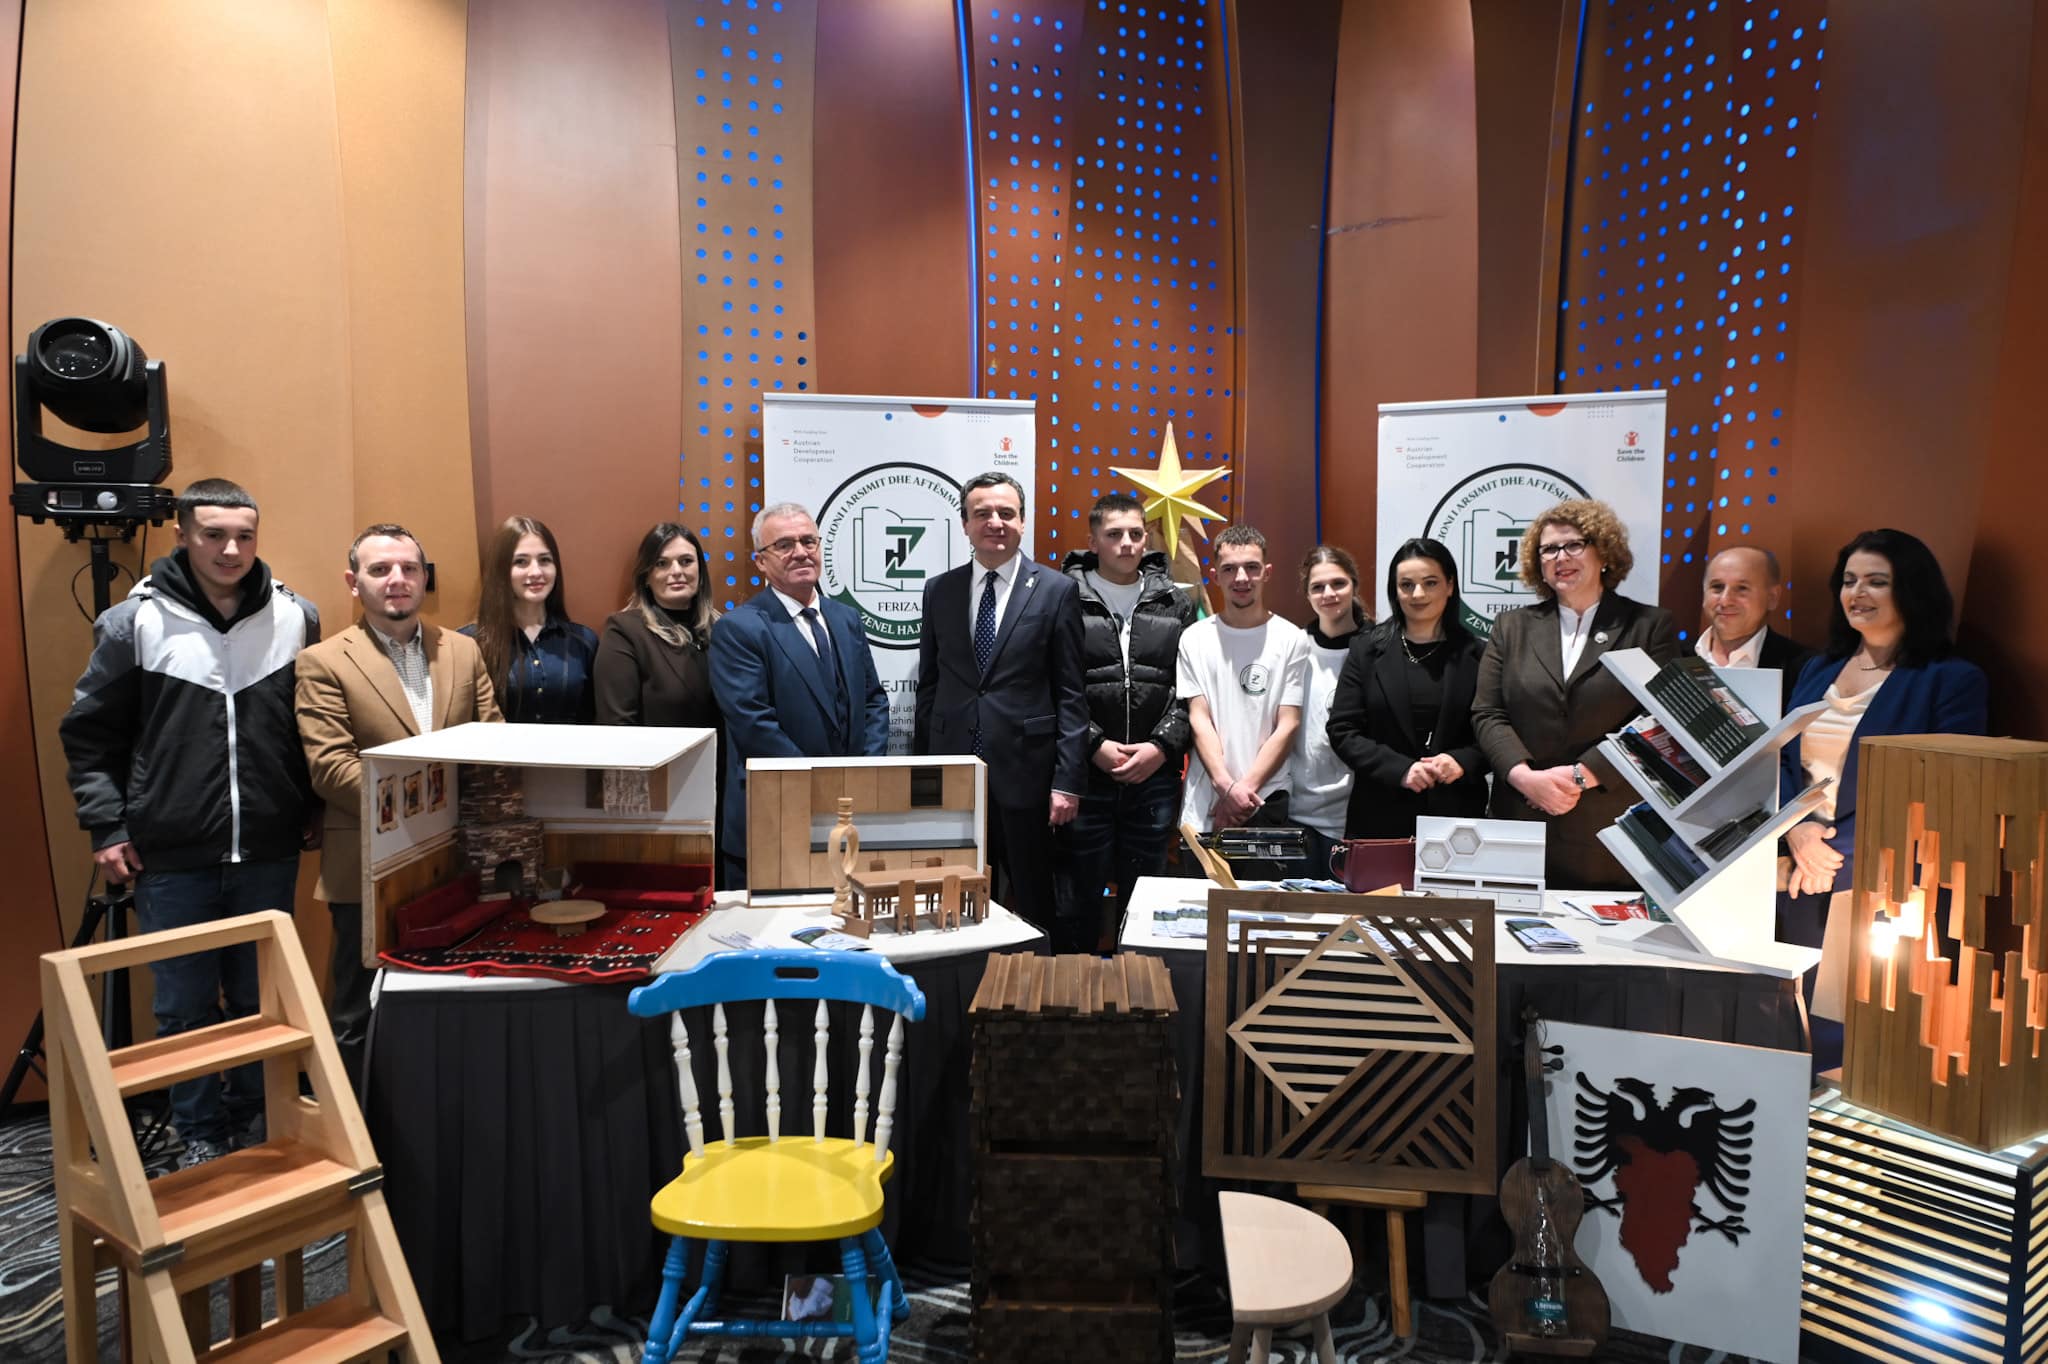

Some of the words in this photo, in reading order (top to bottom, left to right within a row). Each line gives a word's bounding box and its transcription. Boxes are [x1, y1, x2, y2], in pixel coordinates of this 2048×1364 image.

[846, 477, 887, 509] ARSIMIT
[888, 475, 912, 485] DHE
[1456, 479, 1498, 513] ARSIMIT
[1500, 475, 1525, 487] DHE
[861, 612, 896, 635] ZENEL
